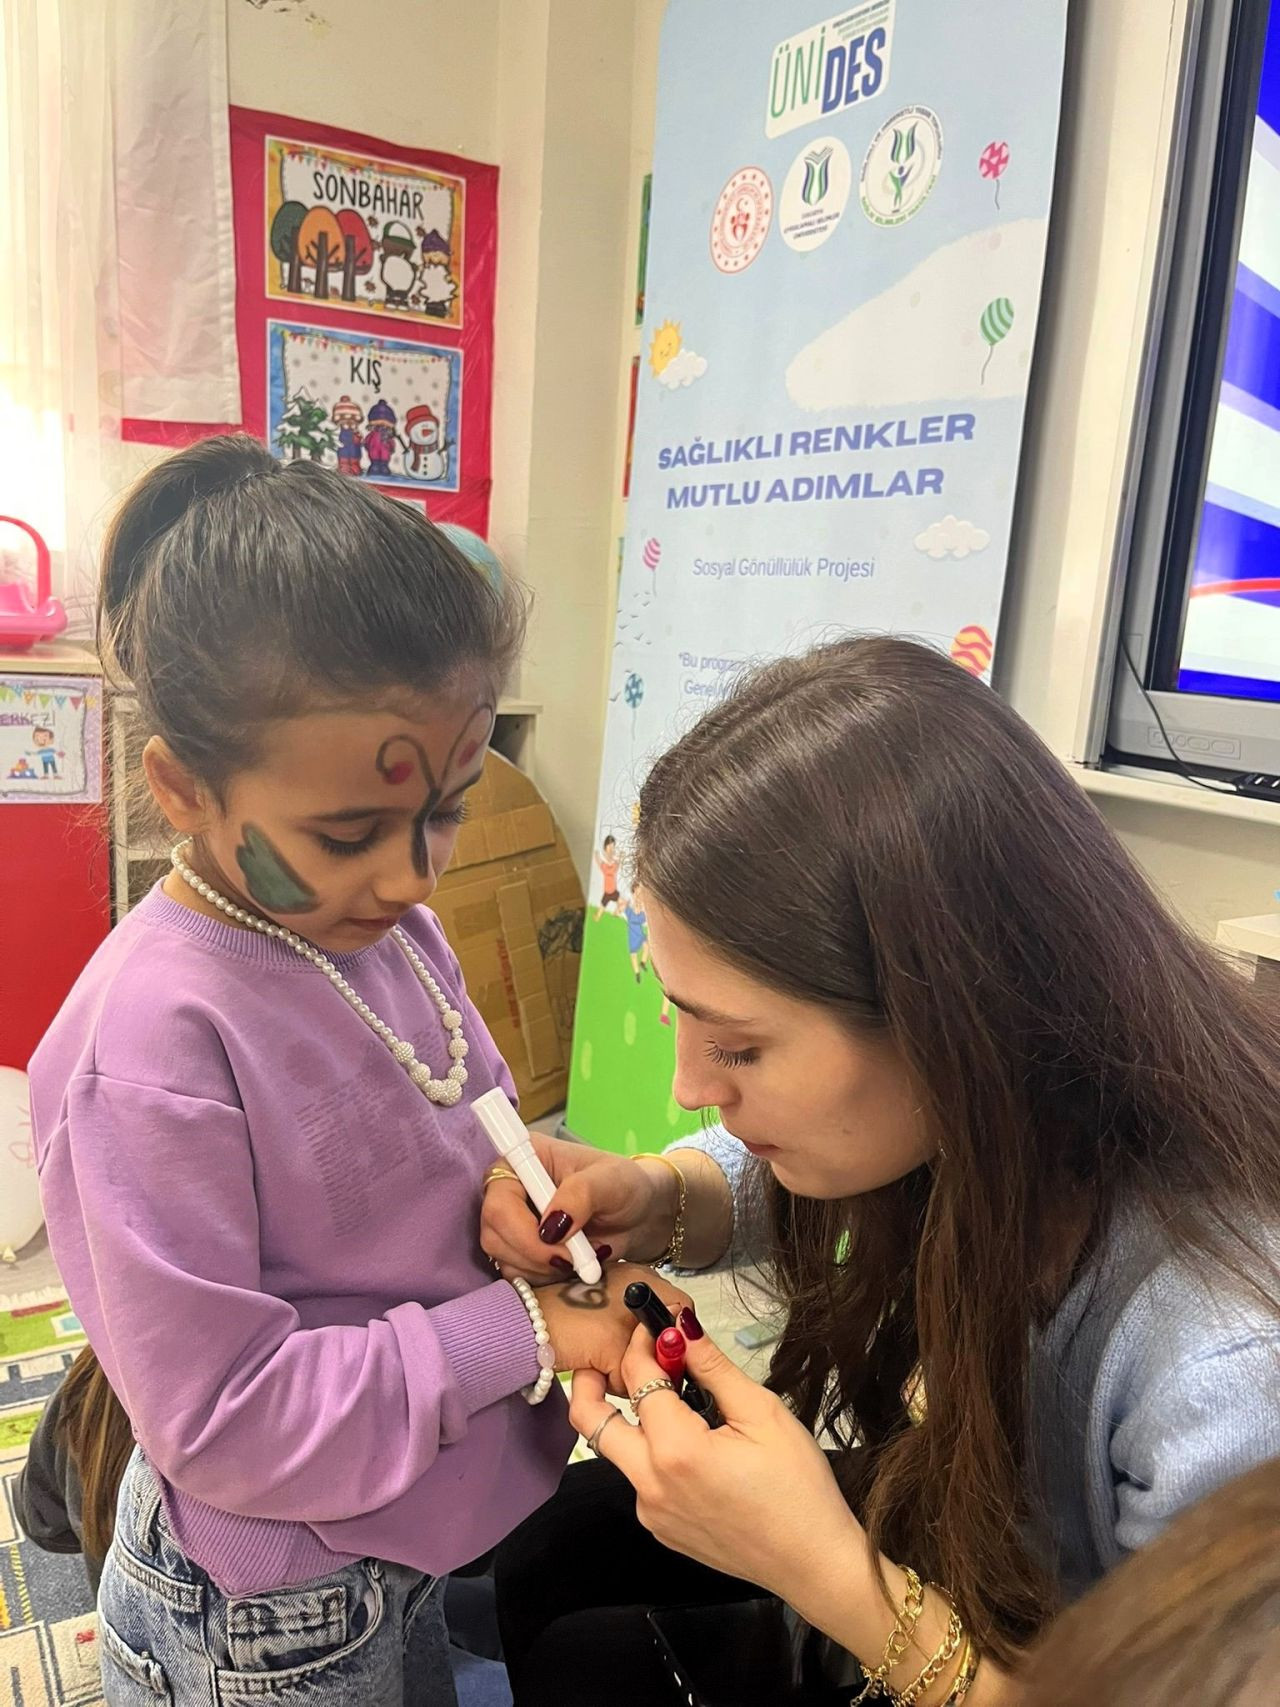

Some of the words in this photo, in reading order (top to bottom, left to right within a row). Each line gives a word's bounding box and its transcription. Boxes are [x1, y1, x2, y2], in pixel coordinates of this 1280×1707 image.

[313, 171, 425, 221] SONBAHAR
[350, 356, 382, 392] KIŞ
[658, 433, 782, 470] SAĞLIKLI
[788, 413, 976, 457] RENKLER
[666, 479, 761, 509] MUTLU
[764, 468, 945, 503] ADIMLAR
[692, 558, 737, 580] Sosyal
[738, 557, 812, 577] Gönüllülük
[816, 557, 876, 582] Projesi
